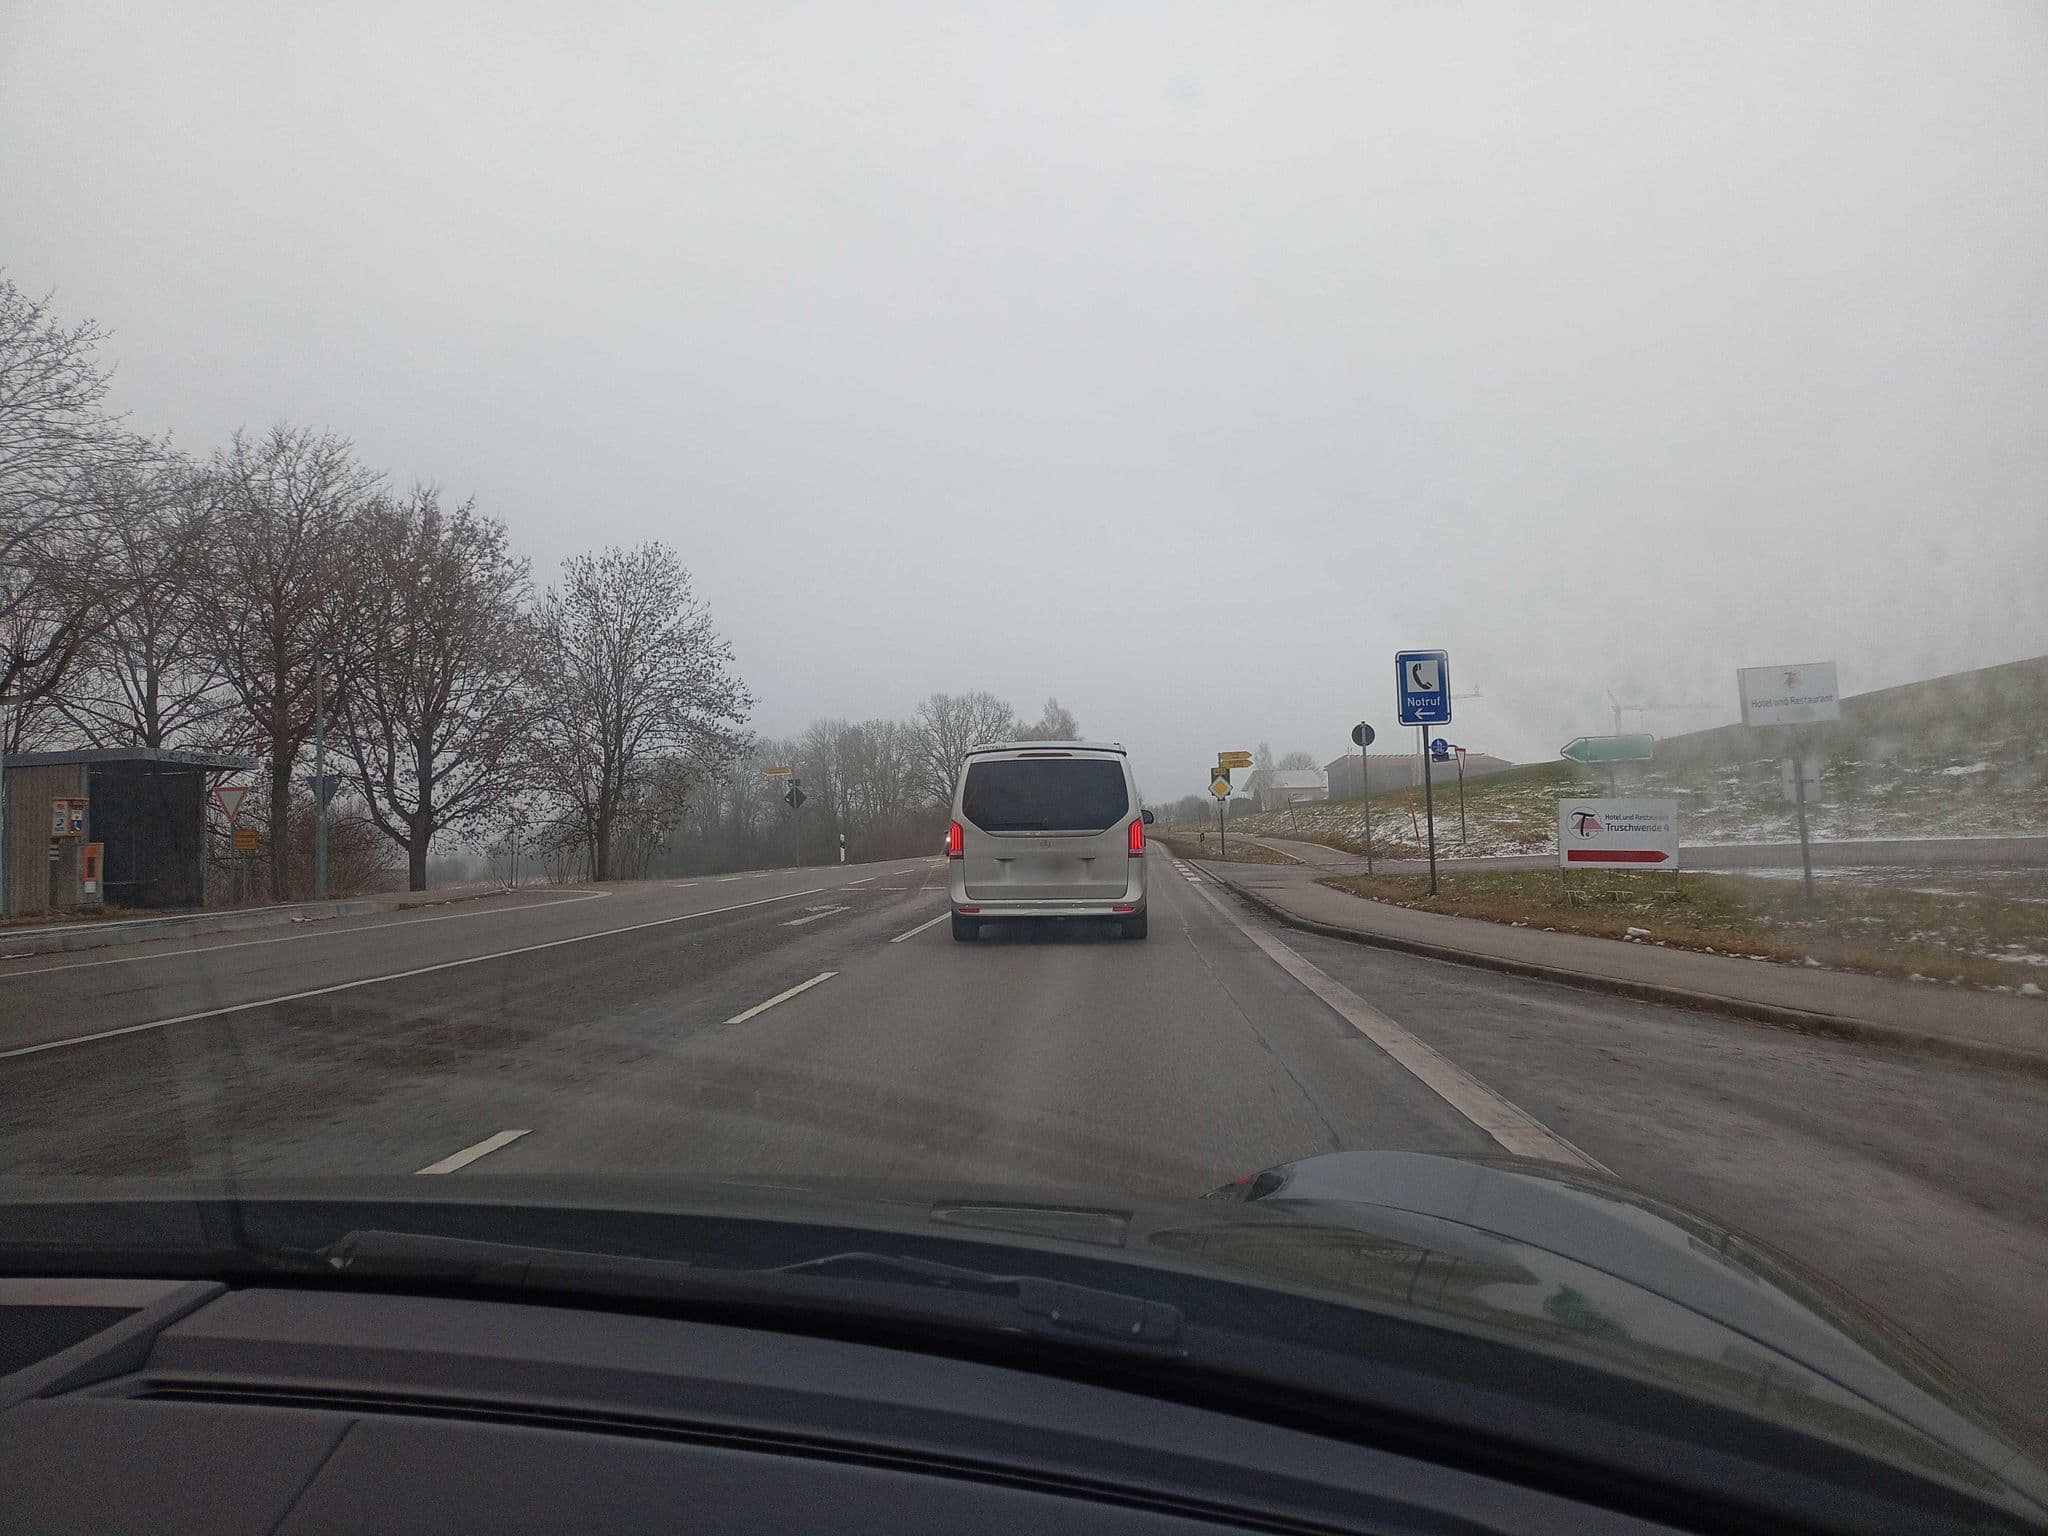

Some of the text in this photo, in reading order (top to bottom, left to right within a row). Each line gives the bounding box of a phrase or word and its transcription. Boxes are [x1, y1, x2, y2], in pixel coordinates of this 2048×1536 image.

[1407, 696, 1441, 707] Notruf
[1752, 695, 1833, 708] Hotel und Restaurant
[1605, 823, 1662, 831] Truschwende
